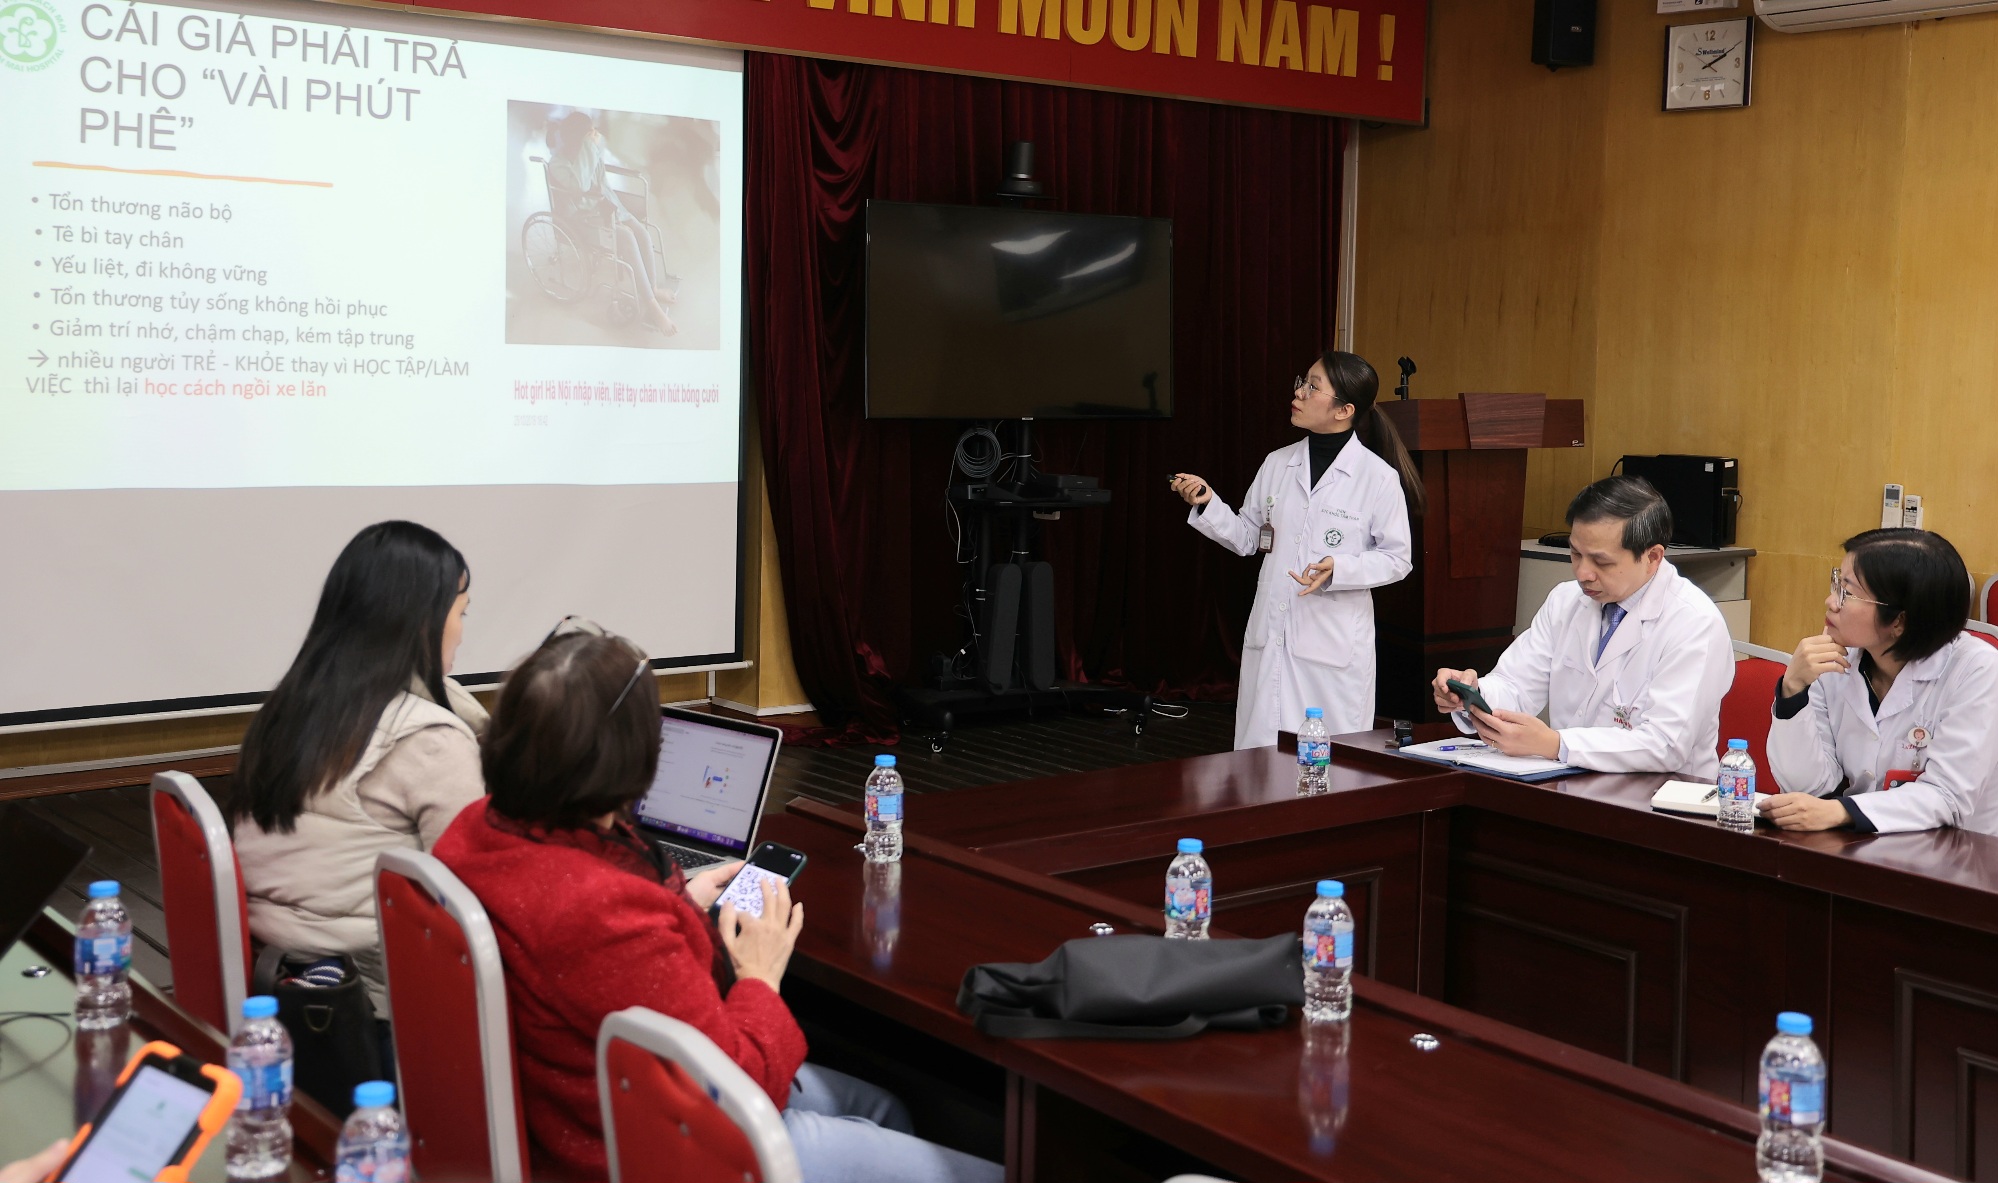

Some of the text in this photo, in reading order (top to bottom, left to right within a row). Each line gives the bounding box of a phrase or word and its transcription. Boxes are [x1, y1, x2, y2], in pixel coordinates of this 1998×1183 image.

[80, 0, 467, 79] CÁI GIÁ PHẢI TRẢ
[1377, 14, 1395, 81] !
[1704, 30, 1716, 41] 12
[1677, 62, 1684, 73] 9
[1734, 57, 1741, 69] 3
[80, 56, 186, 100] CHO
[306, 78, 421, 122] PHÚT
[1703, 90, 1711, 101] 6
[79, 106, 194, 151] PHÊ”
[49, 191, 233, 223] Tổn thương não bộ
[53, 225, 184, 250] Tê bì tay chân
[52, 254, 267, 286] Yếu liệt, đi không vững
[51, 286, 388, 319] Tổn thương tủy sống không hồi phục
[50, 318, 414, 349] Giảm trí nhớ, chậm chạp, kém tập trung
[58, 349, 113, 369] nhiều
[121, 353, 175, 373] người
[182, 350, 216, 371] TRẺ
[235, 351, 285, 372] KHỎE
[291, 356, 329, 376] thay
[334, 358, 347, 374] vì
[354, 359, 391, 377] HỌC
[396, 356, 469, 378] TẬP/LÀM
[84, 377, 109, 394] thì
[117, 377, 138, 397] lại
[144, 378, 178, 398] học
[183, 378, 225, 396] cách
[232, 378, 270, 399] ngồi
[276, 383, 296, 397] xe
[301, 380, 326, 397] lăn
[514, 380, 528, 400] Hot
[530, 380, 543, 405] girl
[545, 380, 556, 400] Hà
[558, 380, 571, 406] Nội
[573, 380, 592, 406] nhập
[626, 384, 637, 407] tay
[639, 383, 657, 403] chân
[682, 384, 699, 408] bóng
